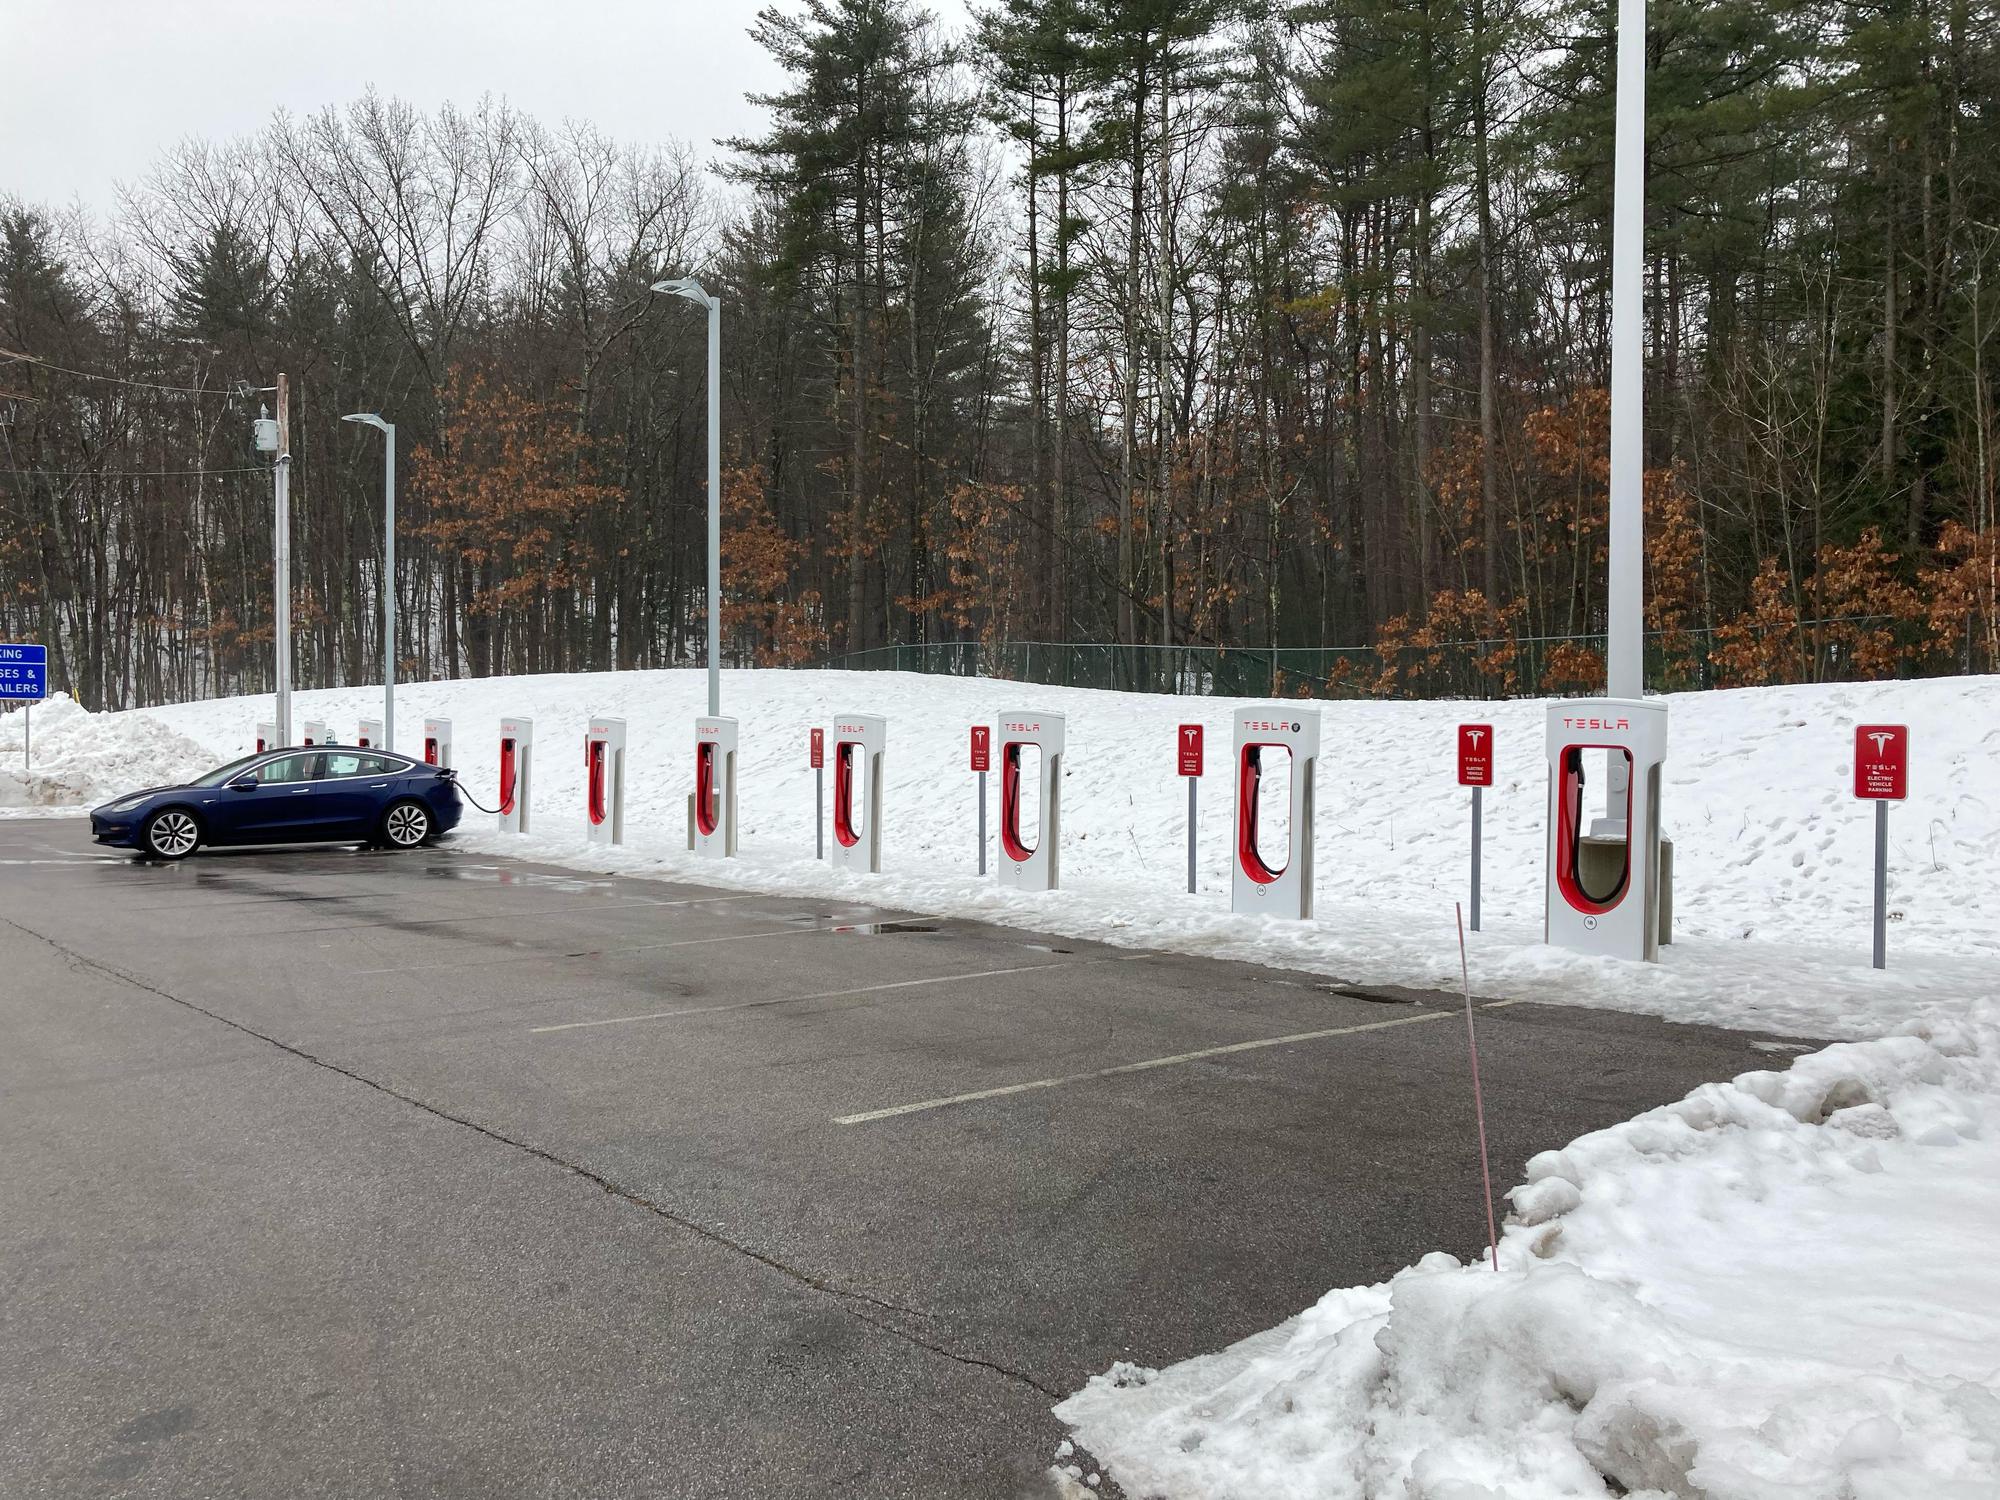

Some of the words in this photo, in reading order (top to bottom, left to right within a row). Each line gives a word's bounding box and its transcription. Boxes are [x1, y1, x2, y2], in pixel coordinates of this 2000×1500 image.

[27, 669, 36, 679] &
[838, 725, 865, 733] TESLA
[1004, 723, 1040, 732] TESLA
[1243, 721, 1289, 731] TESLA
[1563, 718, 1629, 730] TESLA
